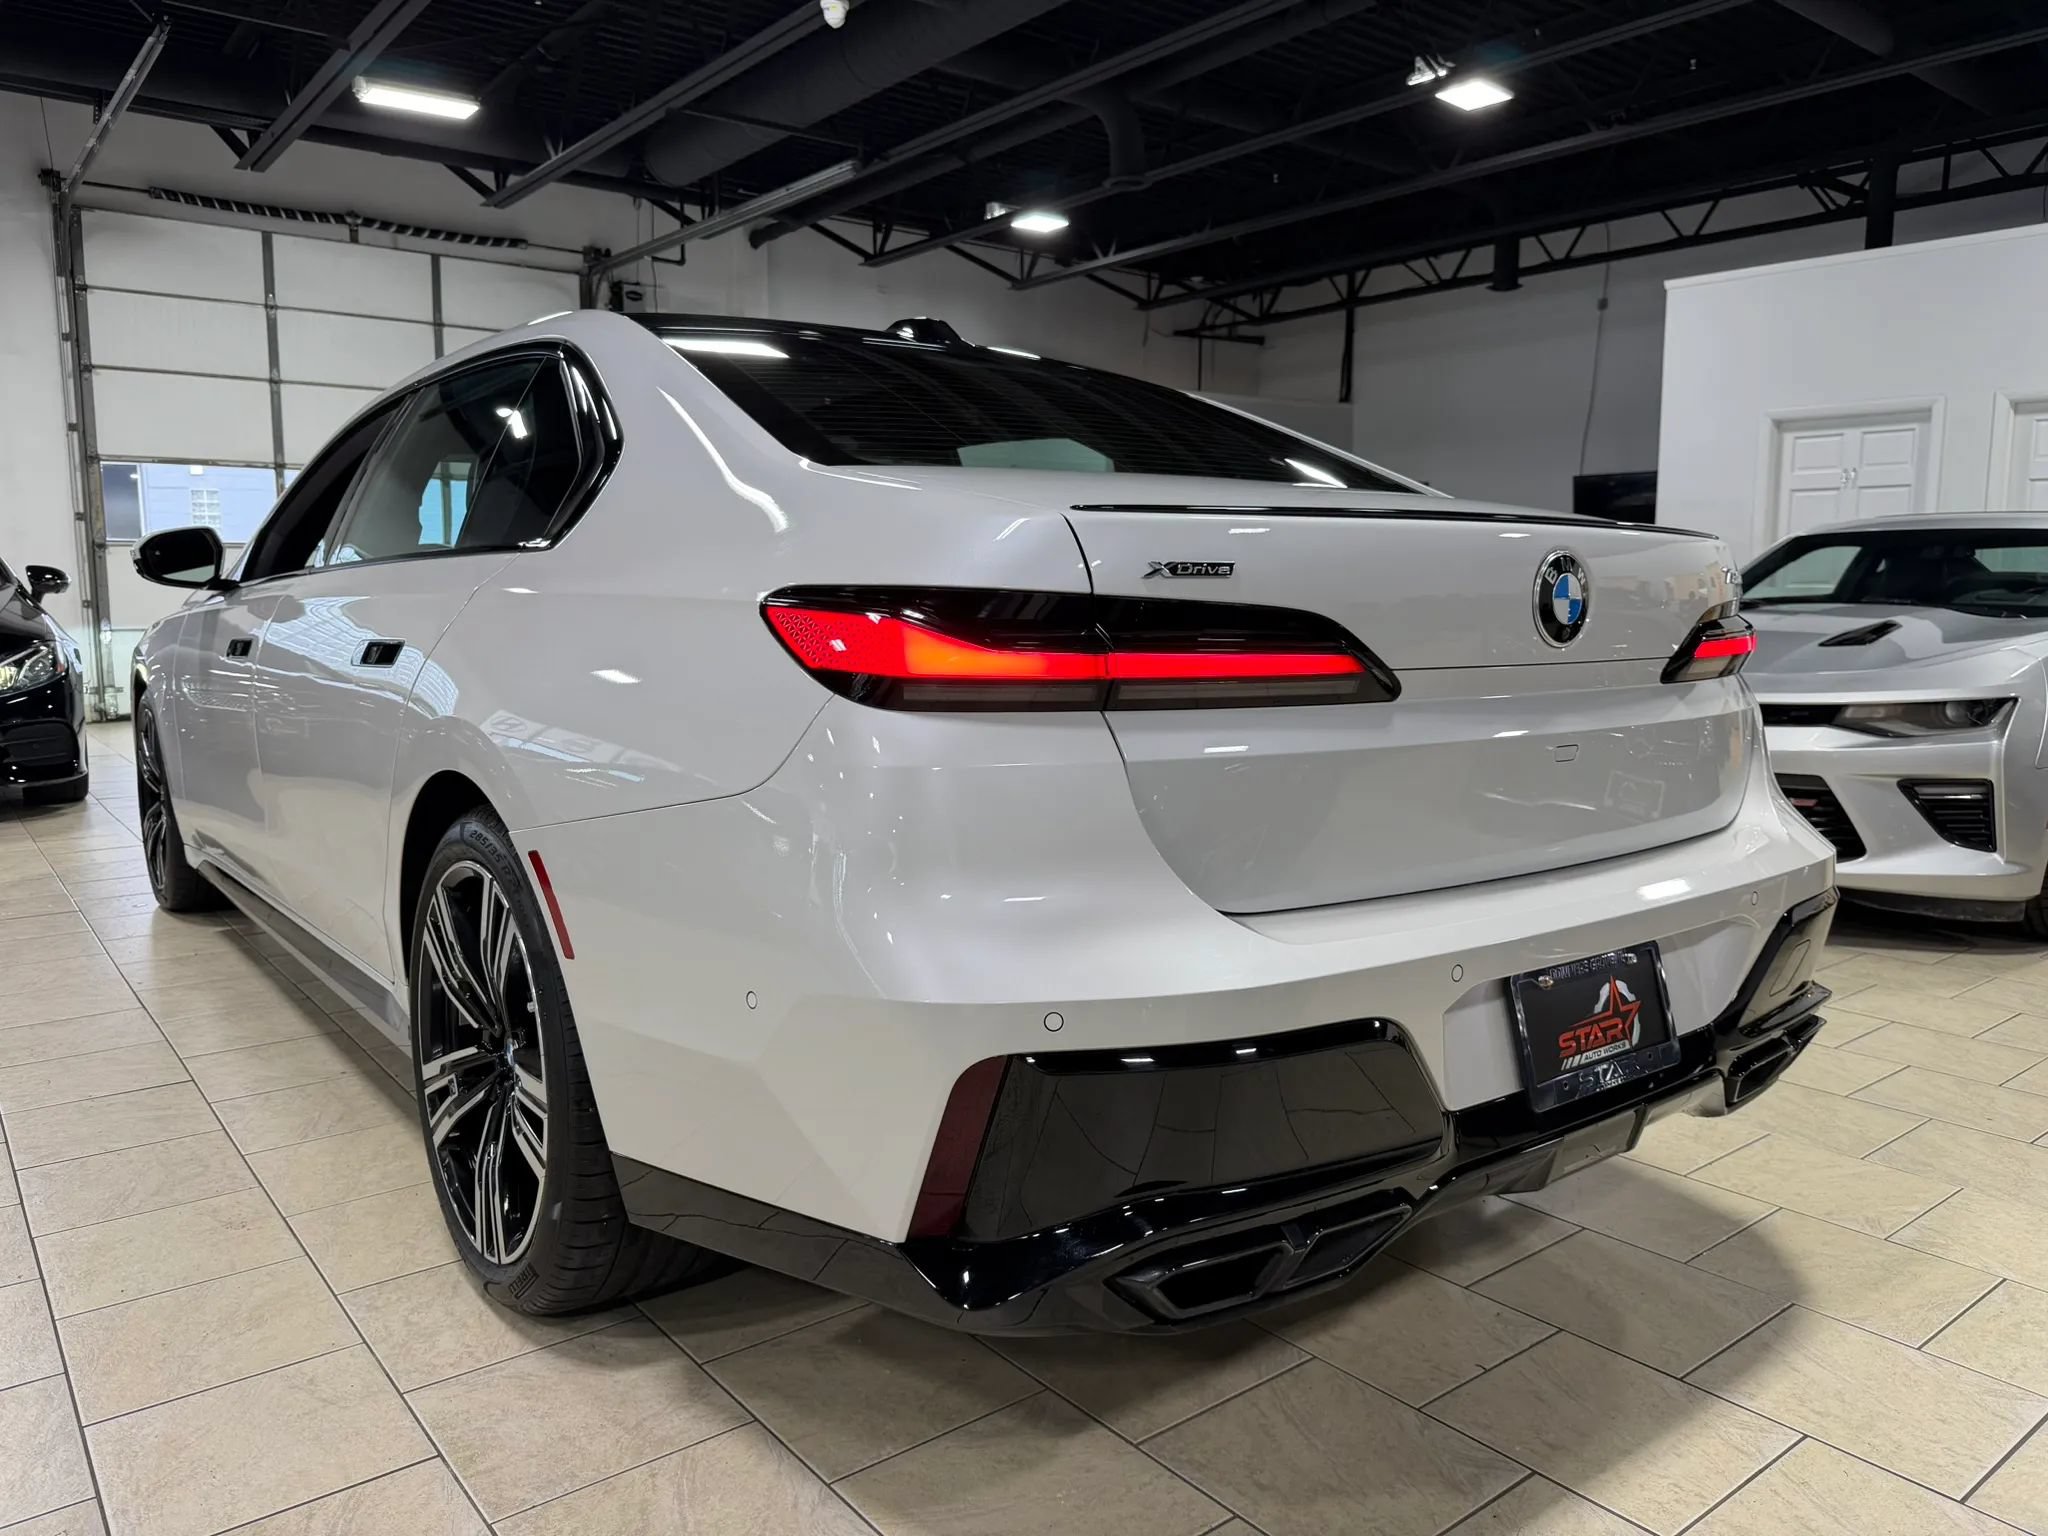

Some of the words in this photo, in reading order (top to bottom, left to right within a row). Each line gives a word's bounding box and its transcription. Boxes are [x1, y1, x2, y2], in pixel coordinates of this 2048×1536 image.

[1544, 557, 1586, 585] BMW
[1558, 1018, 1623, 1058] STAR
[1584, 1050, 1602, 1061] AUTO
[1603, 1041, 1627, 1055] WORKS
